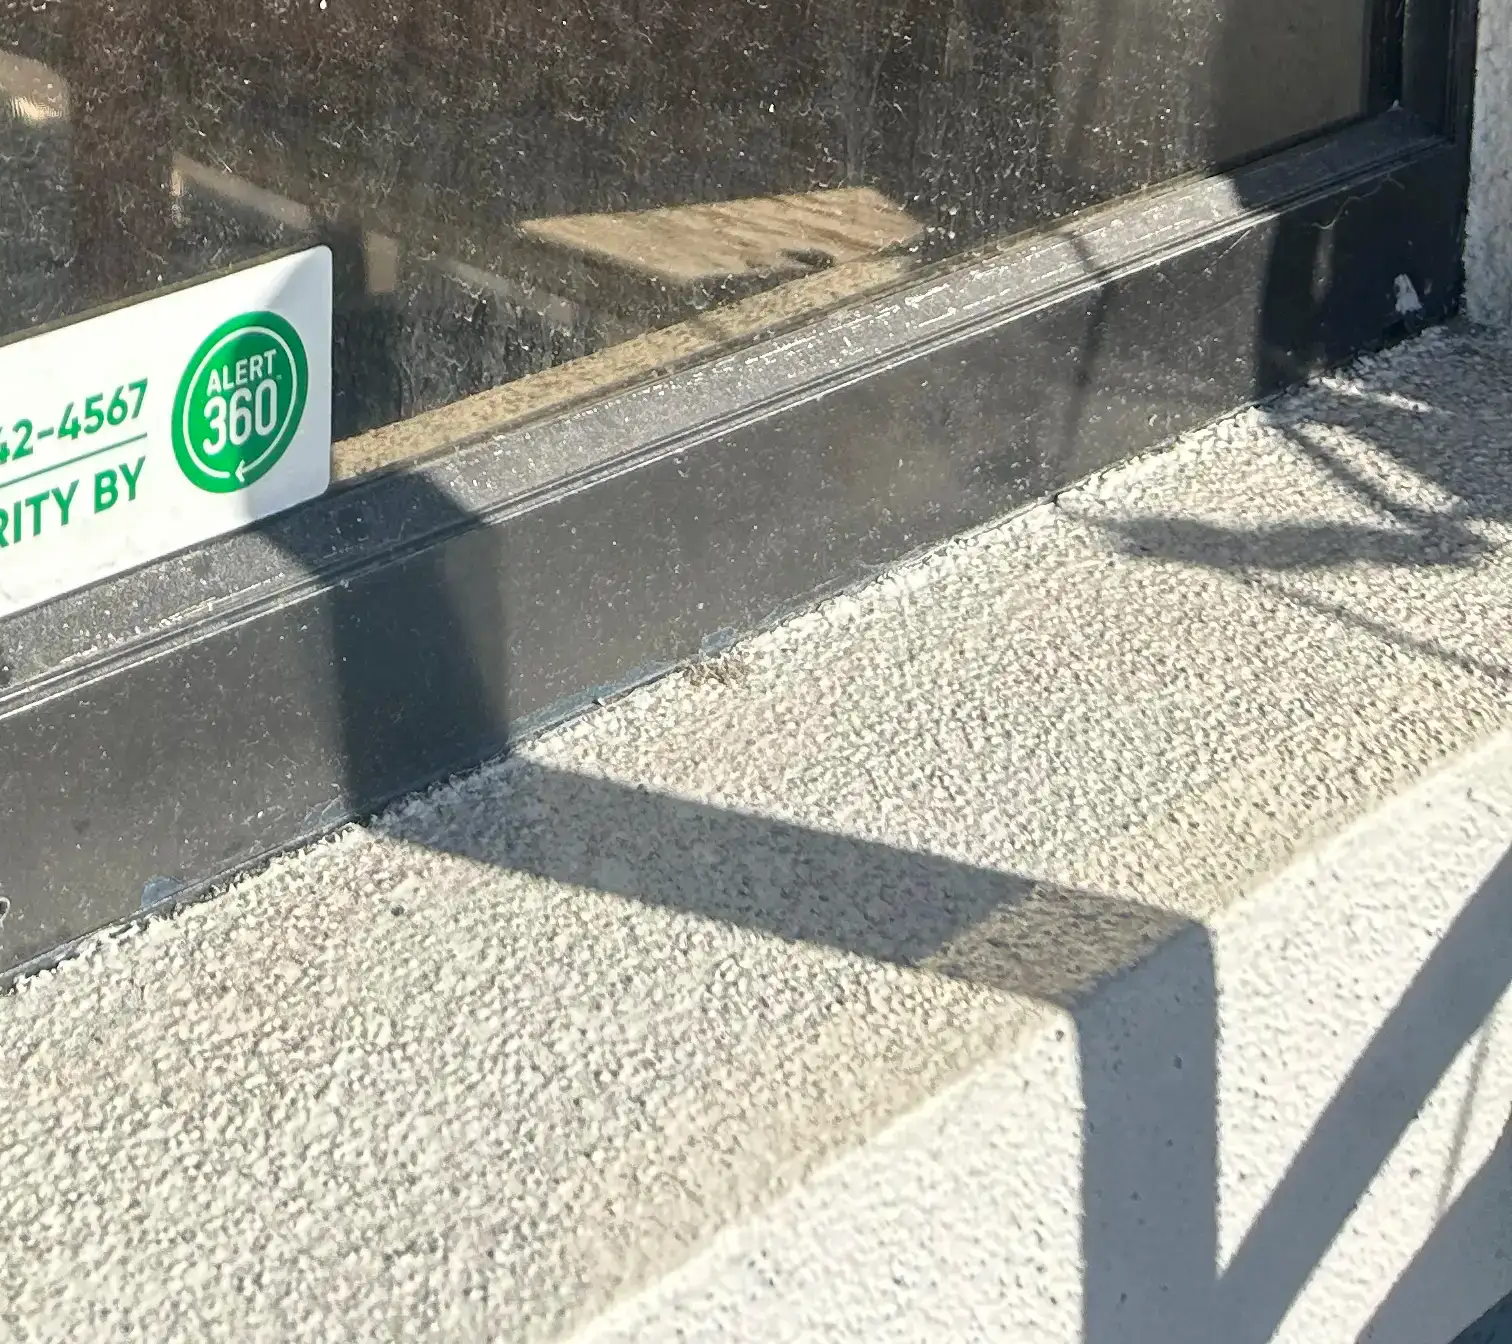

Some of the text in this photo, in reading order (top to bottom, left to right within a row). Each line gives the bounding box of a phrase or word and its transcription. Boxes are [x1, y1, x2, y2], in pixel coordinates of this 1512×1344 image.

[207, 348, 277, 396] ALERT
[202, 379, 278, 456] 360
[93, 456, 146, 516] BY
